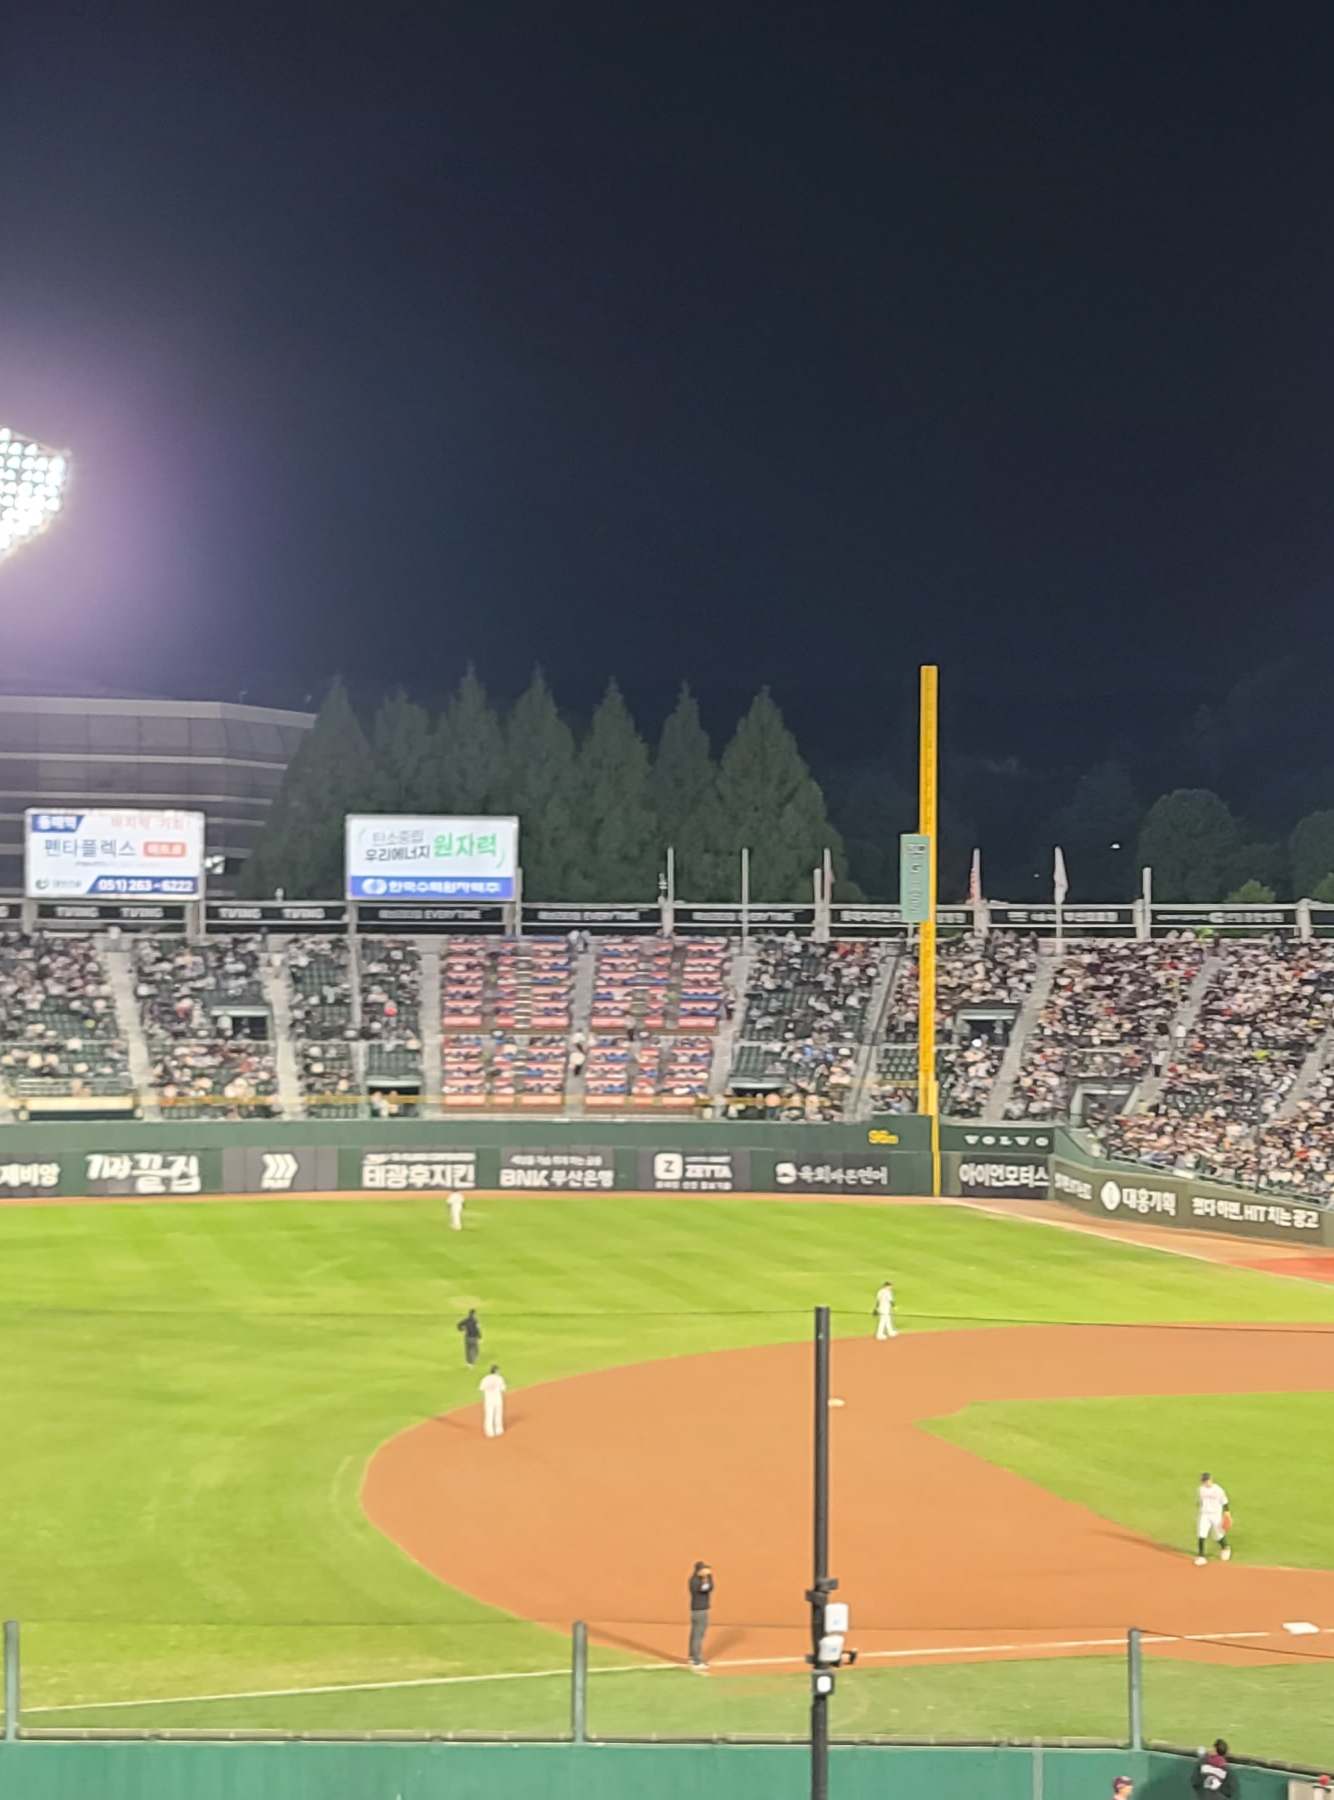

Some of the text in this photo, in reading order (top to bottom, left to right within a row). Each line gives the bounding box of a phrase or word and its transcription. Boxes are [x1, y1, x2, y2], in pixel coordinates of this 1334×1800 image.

[372, 830, 424, 847] 탄소중립
[433, 833, 498, 858] 원자력
[45, 839, 137, 858] 펜타플렉스
[365, 846, 430, 862] 우리에너지
[964, 1133, 1050, 1148] VOLVO
[362, 1164, 476, 1188] 태광후지킨
[499, 1168, 615, 1189] BNK 부산은행
[684, 1164, 733, 1179] ZETTA
[959, 1162, 1050, 1188] 아이언모터스
[1122, 1187, 1177, 1217] 대홍기획
[1244, 1205, 1267, 1223] HIT
